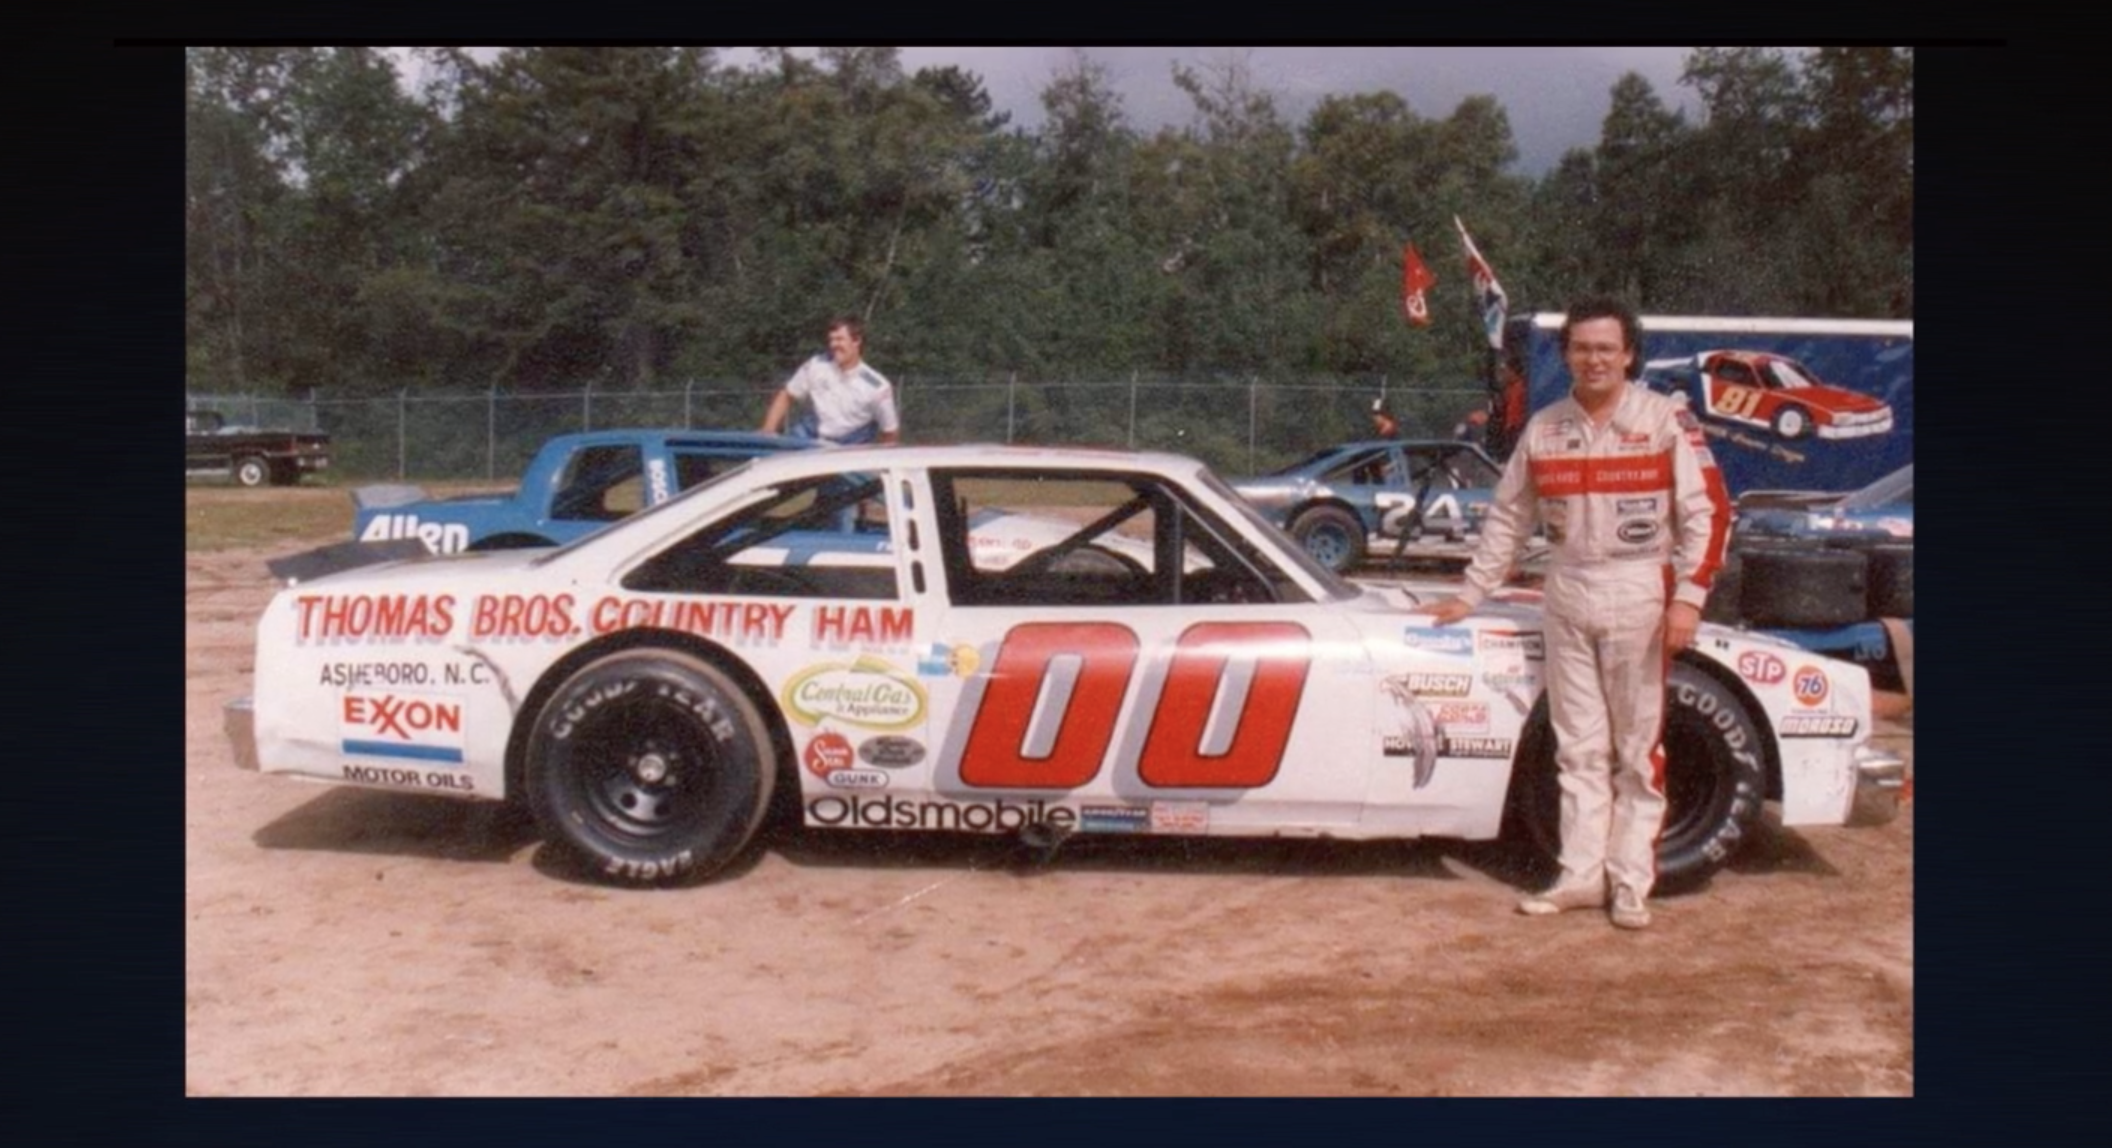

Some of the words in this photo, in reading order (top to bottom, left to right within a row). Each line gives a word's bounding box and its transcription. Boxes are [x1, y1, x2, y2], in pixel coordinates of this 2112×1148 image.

[1713, 386, 1763, 418] 81
[1375, 492, 1467, 541] 24
[297, 593, 456, 638] THOMAS
[474, 594, 581, 636] BROS.
[816, 605, 914, 642] HAM
[1408, 674, 1471, 691] BUSCH
[1741, 653, 1781, 683] STP
[801, 680, 872, 703] Central
[873, 682, 912, 704] Gas
[1800, 675, 1822, 695] 76
[343, 694, 460, 740] EXXON
[958, 620, 1313, 789] 00
[343, 765, 421, 786] MOTOR
[426, 771, 475, 790] OILS
[834, 773, 880, 786] GUNK
[808, 795, 1077, 831] Oldsmobile
